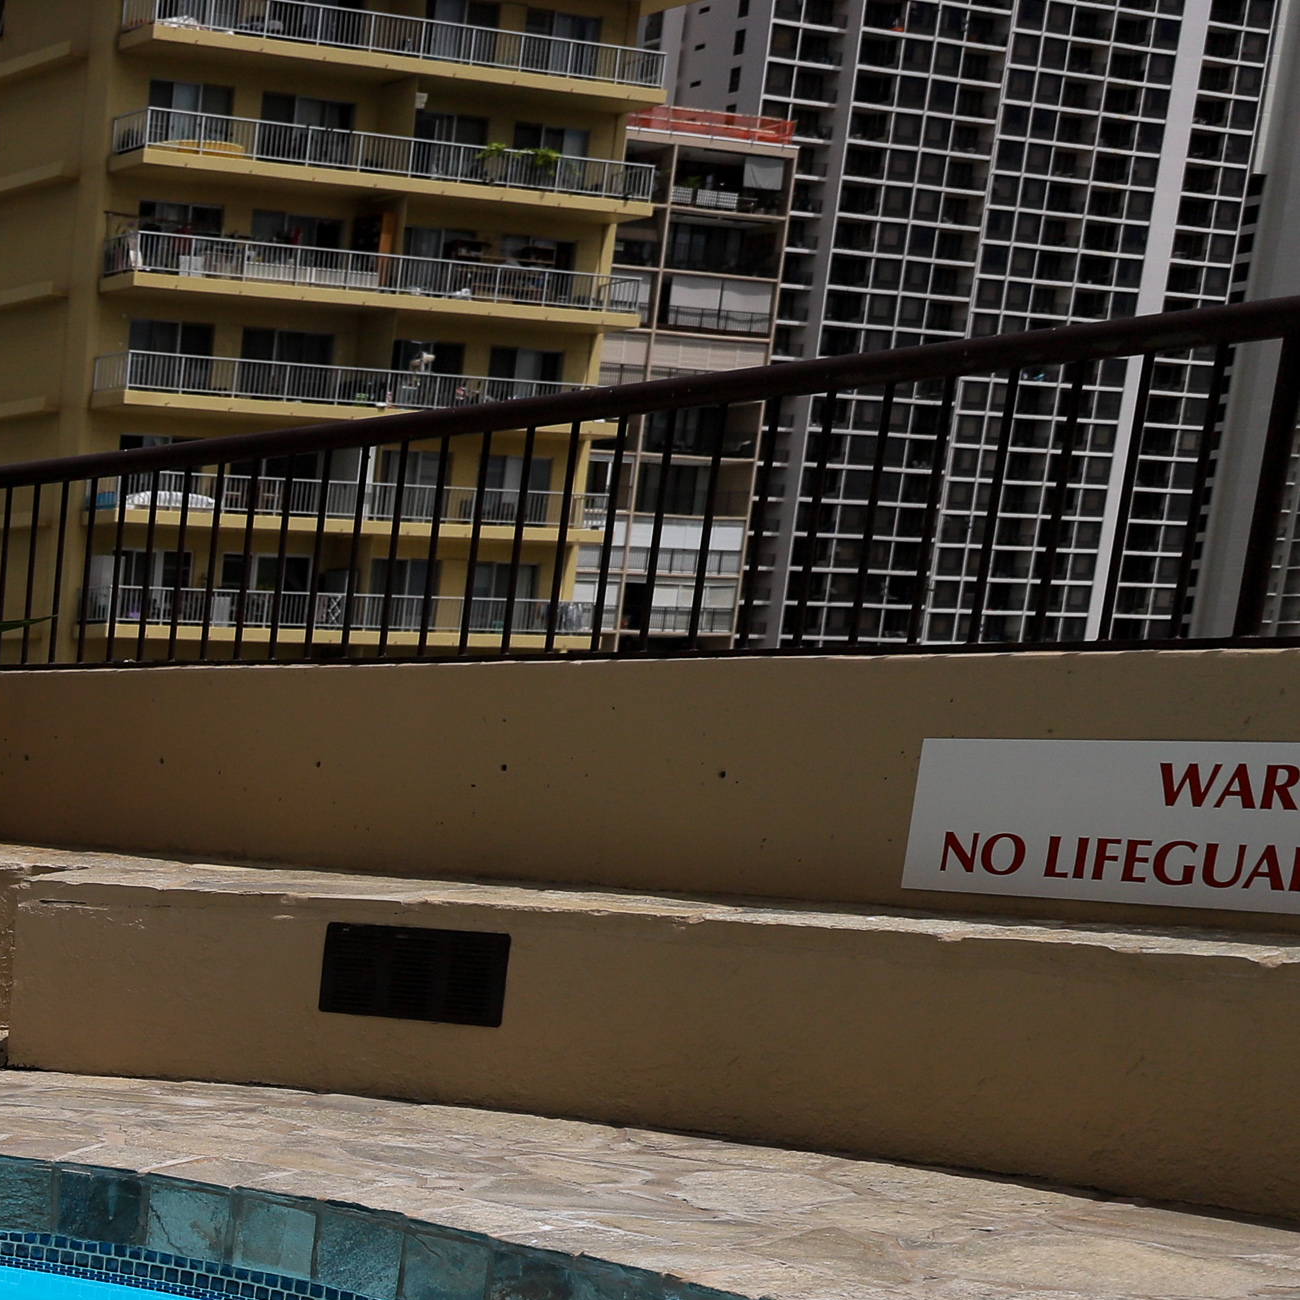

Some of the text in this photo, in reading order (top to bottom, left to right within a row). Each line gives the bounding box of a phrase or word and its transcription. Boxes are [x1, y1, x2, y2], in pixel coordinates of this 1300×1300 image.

[1160, 763, 1300, 810] WAR
[940, 831, 1300, 892] NO LIFEGUA
